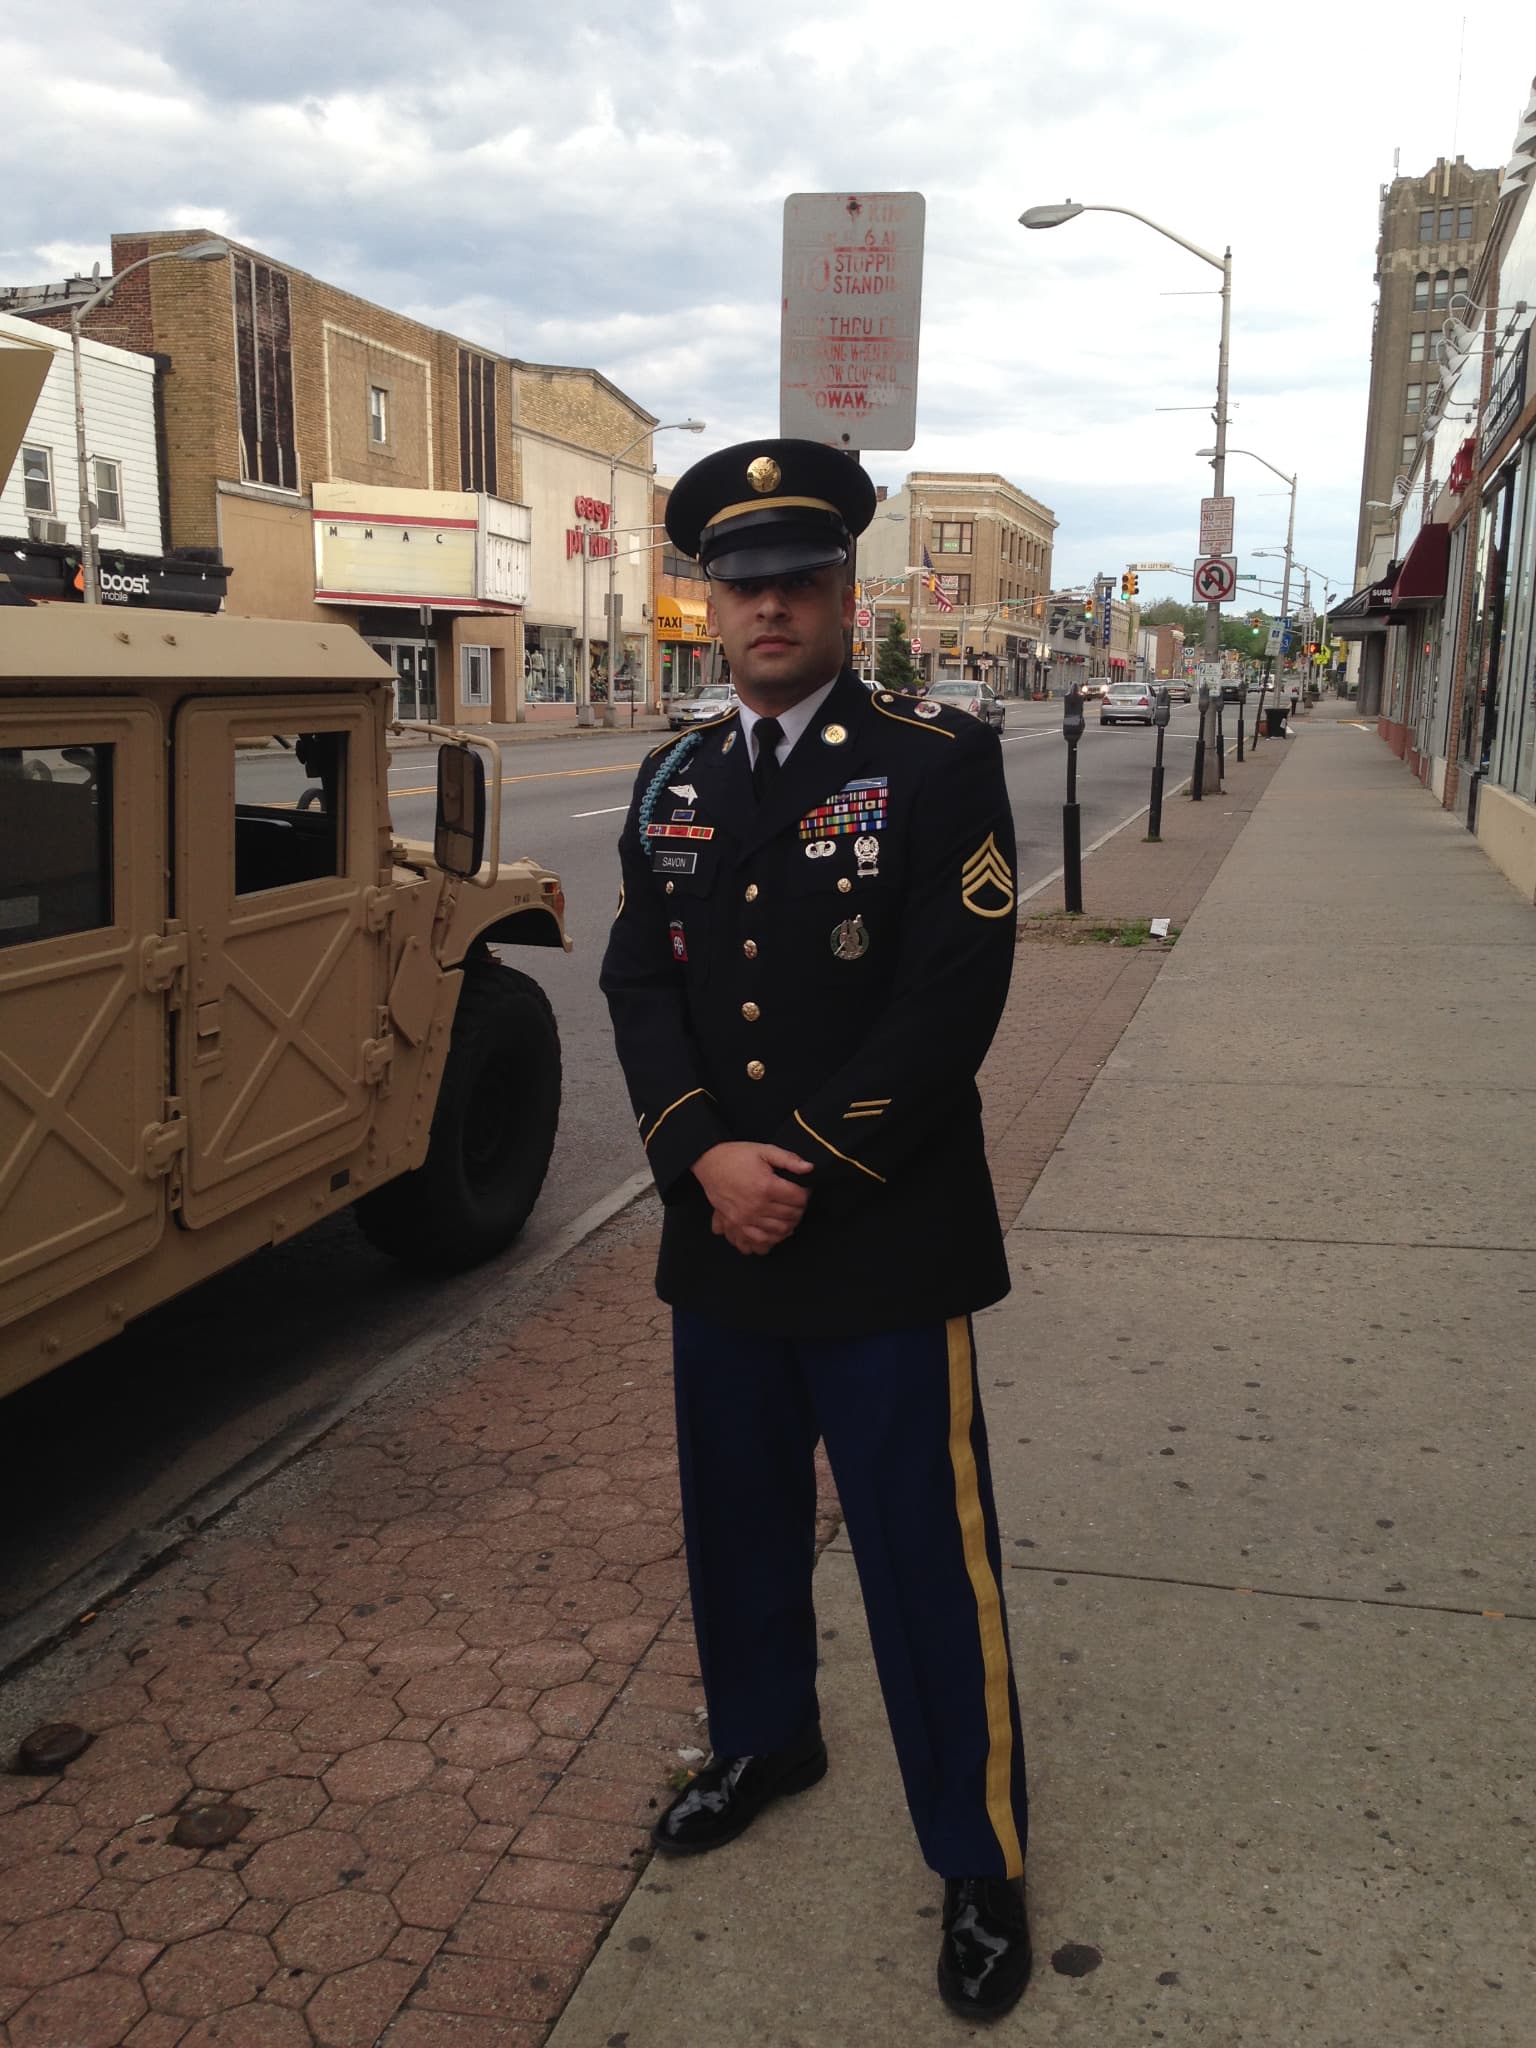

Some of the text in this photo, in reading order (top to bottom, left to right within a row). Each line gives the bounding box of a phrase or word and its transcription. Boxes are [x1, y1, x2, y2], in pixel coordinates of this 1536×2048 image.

[833, 275, 900, 295] STANDI
[574, 495, 611, 530] easy
[329, 526, 443, 544] M M A C
[100, 568, 150, 594] boost
[101, 591, 129, 602] mobile
[658, 616, 683, 629] TAXI
[694, 623, 708, 637] TA
[662, 857, 686, 868] SAVON
